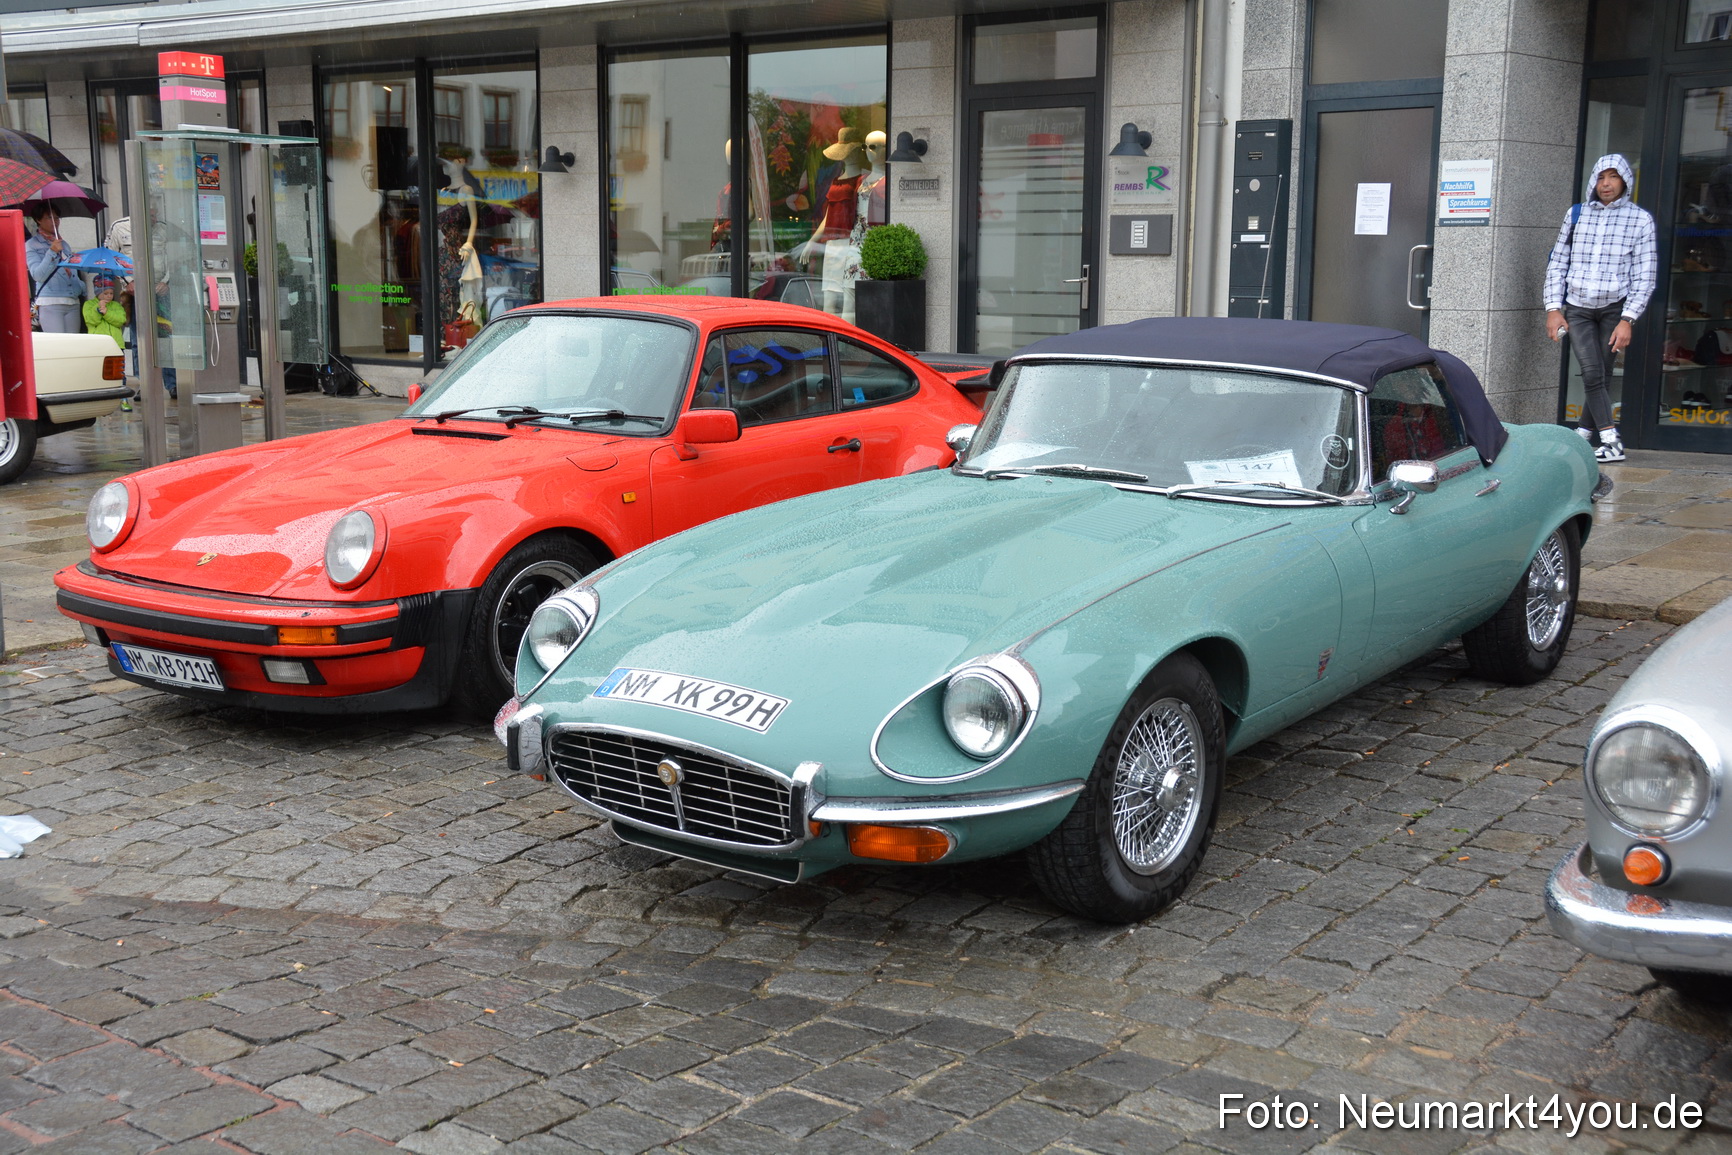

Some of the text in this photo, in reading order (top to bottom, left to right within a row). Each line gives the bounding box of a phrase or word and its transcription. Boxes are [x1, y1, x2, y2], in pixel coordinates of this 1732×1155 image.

[190, 87, 217, 99] HotSpot
[899, 180, 939, 190] SCHNEIDER
[1113, 183, 1144, 191] REMBS
[1443, 182, 1473, 190] Nachhilfe
[1450, 199, 1488, 208] Sprachkurse
[331, 282, 404, 293] new collection
[612, 284, 707, 296] new collection
[348, 295, 372, 305] spring
[379, 296, 412, 304] summer
[1240, 462, 1274, 471] 147
[123, 648, 149, 673] NM
[612, 672, 662, 698] NM
